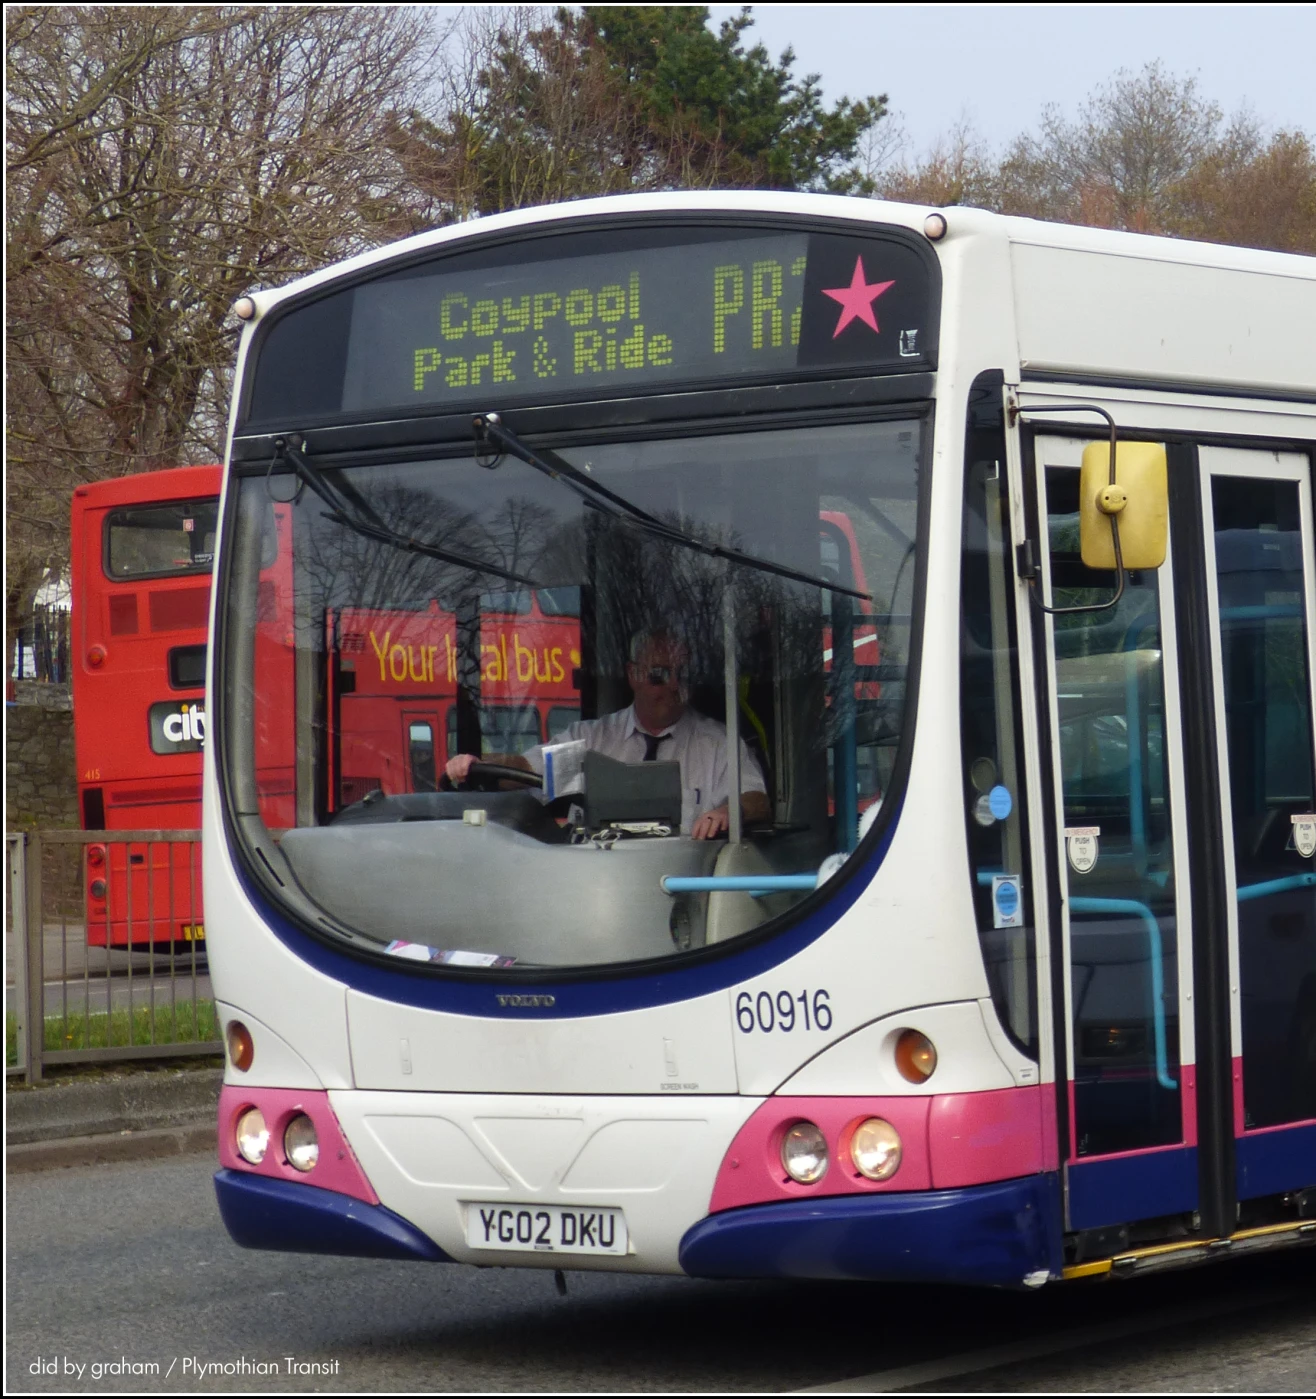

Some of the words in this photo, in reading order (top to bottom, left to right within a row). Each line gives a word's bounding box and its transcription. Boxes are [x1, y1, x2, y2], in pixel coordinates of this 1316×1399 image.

[440, 271, 640, 340] Coypool
[414, 340, 517, 391] Park
[533, 336, 557, 378] &
[574, 325, 673, 375] Ride
[369, 631, 438, 683] Your
[445, 633, 508, 682] lal
[514, 633, 565, 683] bus
[85, 769, 100, 780] 415
[1076, 857, 1091, 865] OPEN
[495, 994, 556, 1007] VOLVO
[735, 989, 833, 1033] 60916
[480, 1209, 552, 1245] YG02
[560, 1212, 615, 1248] DKU
